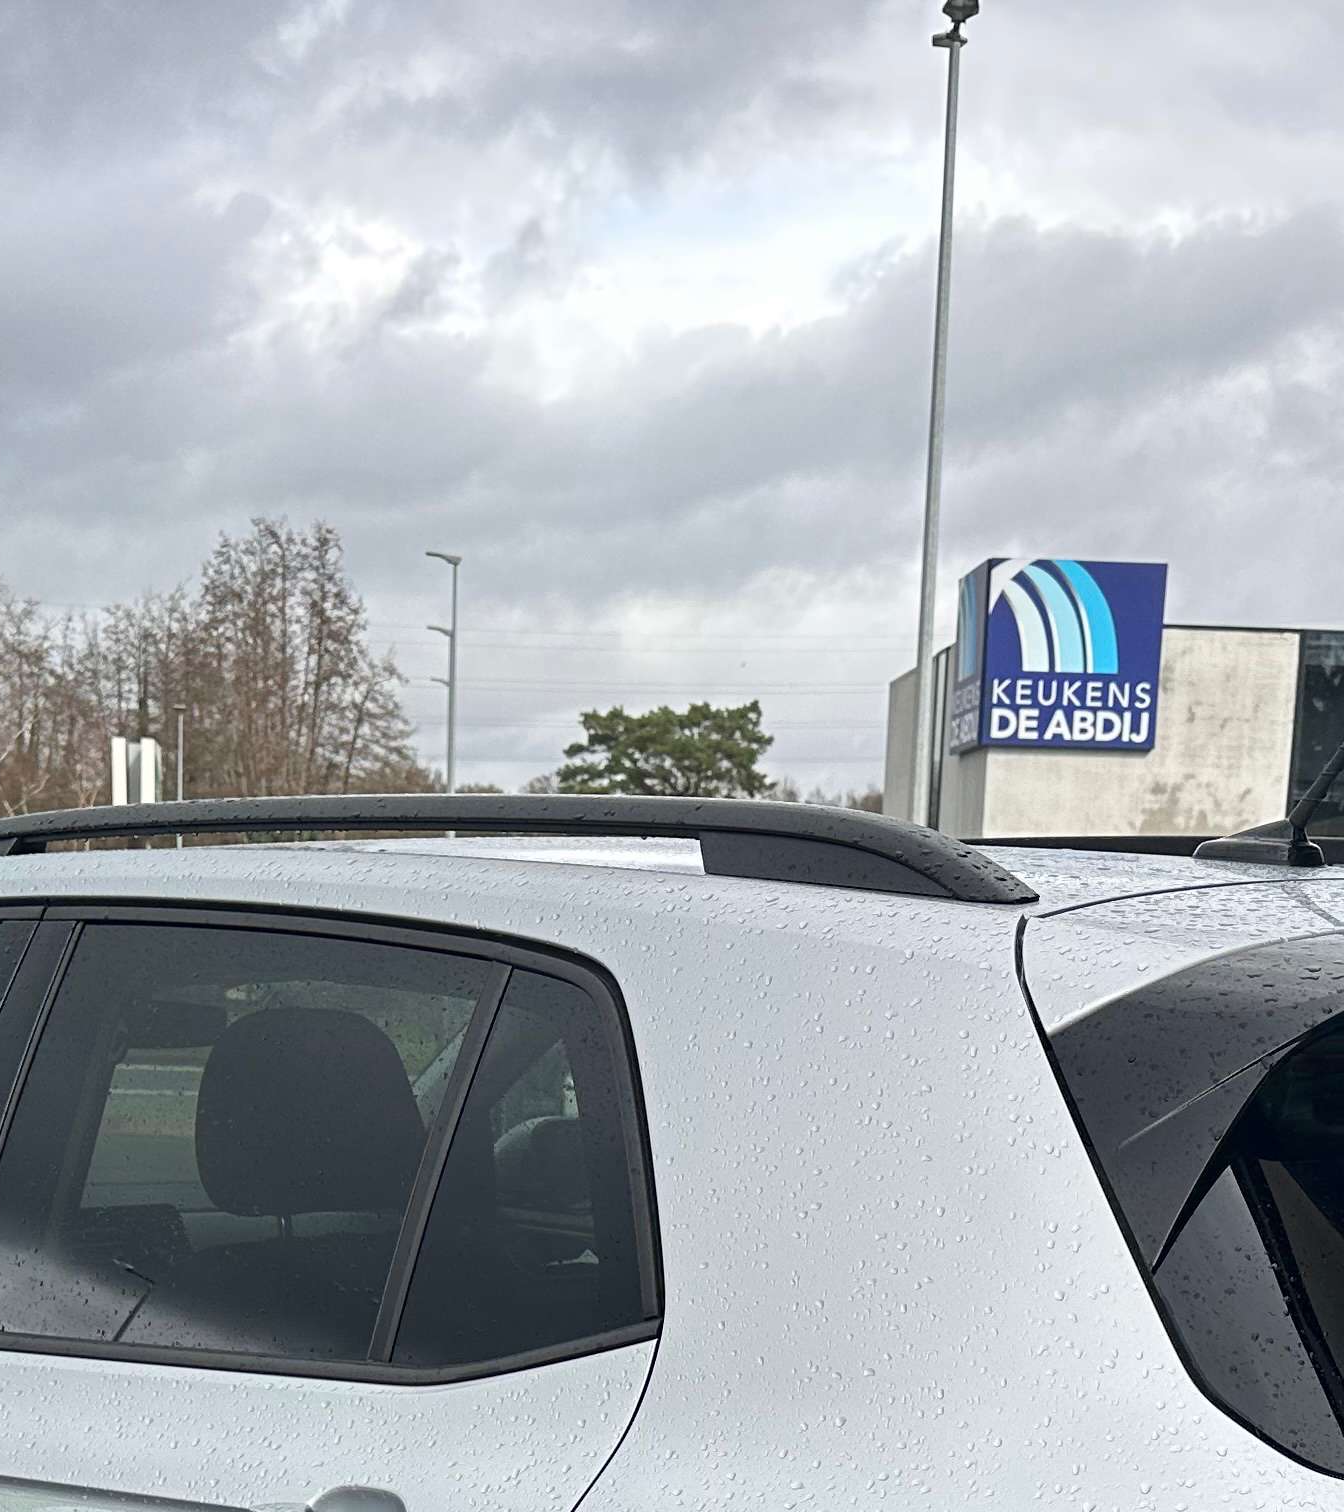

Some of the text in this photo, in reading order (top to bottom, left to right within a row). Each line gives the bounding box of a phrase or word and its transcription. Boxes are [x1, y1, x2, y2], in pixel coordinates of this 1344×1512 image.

[991, 678, 1152, 709] KEUKENS
[989, 707, 1040, 740] DE
[1042, 709, 1151, 744] ABDIJ
